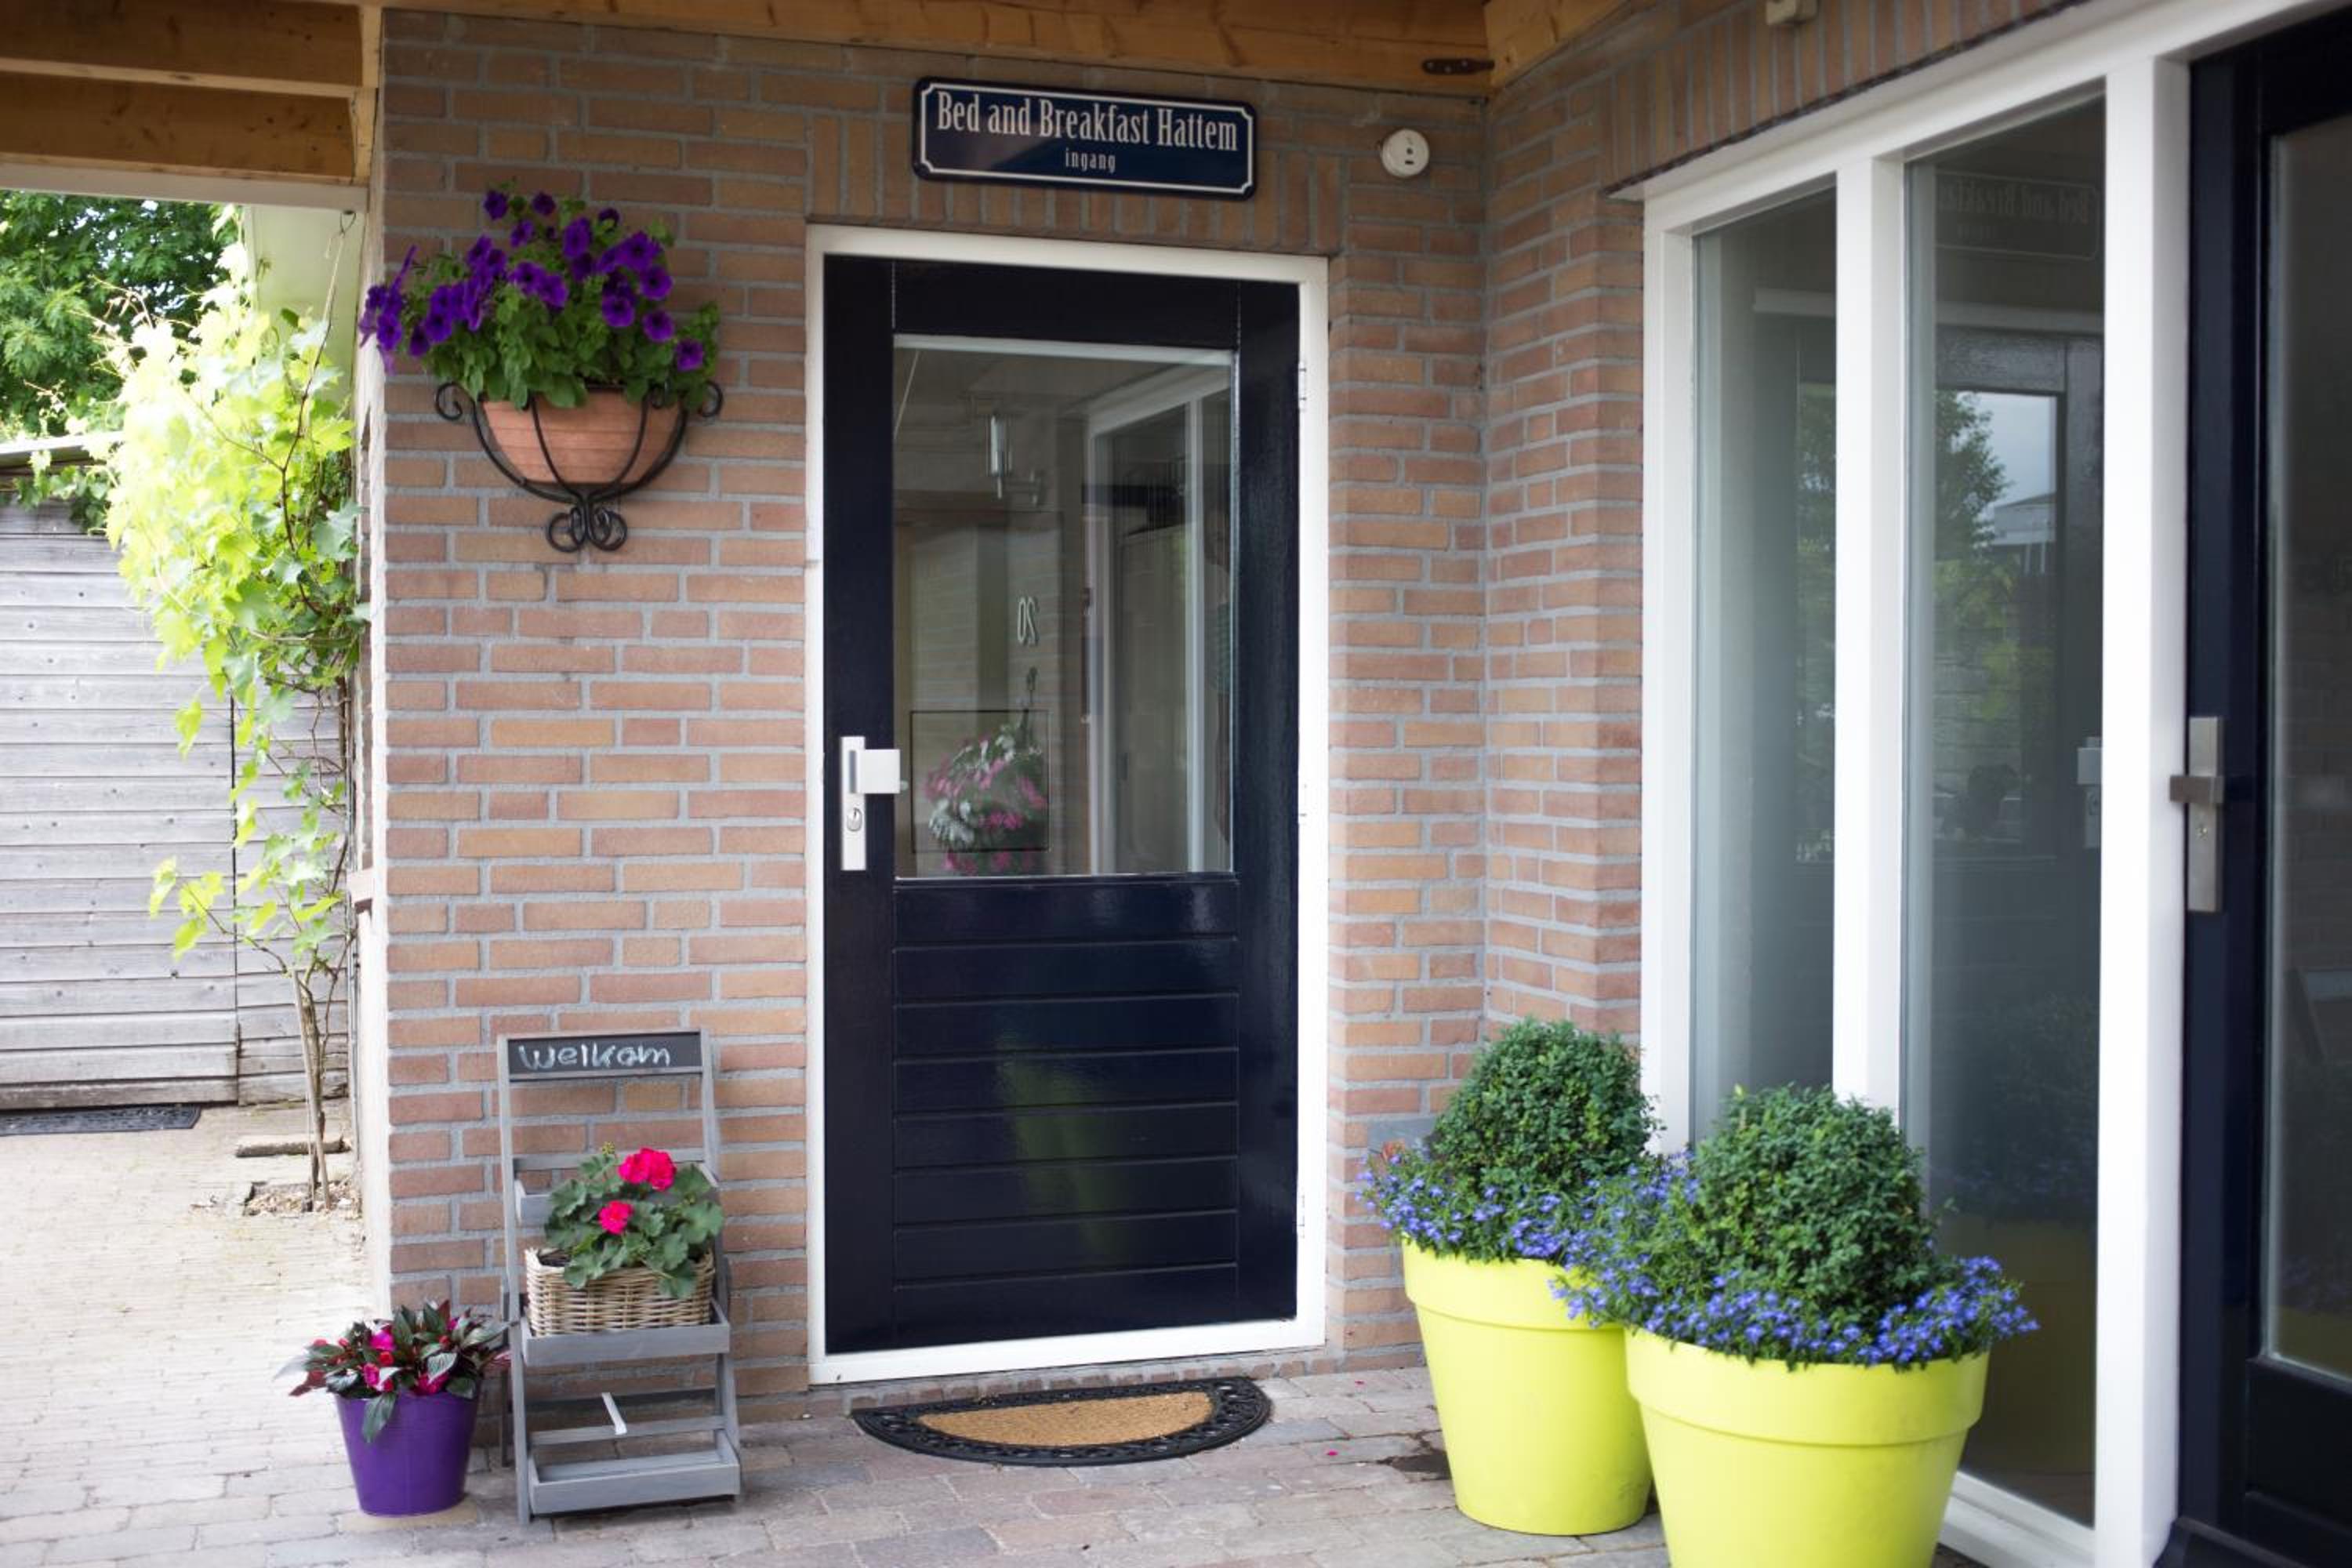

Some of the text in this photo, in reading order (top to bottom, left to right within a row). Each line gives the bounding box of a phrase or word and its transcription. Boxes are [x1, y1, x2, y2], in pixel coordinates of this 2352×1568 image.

[937, 90, 1239, 151] Bed and Breakfast Hattem
[1065, 147, 1116, 174] ingang
